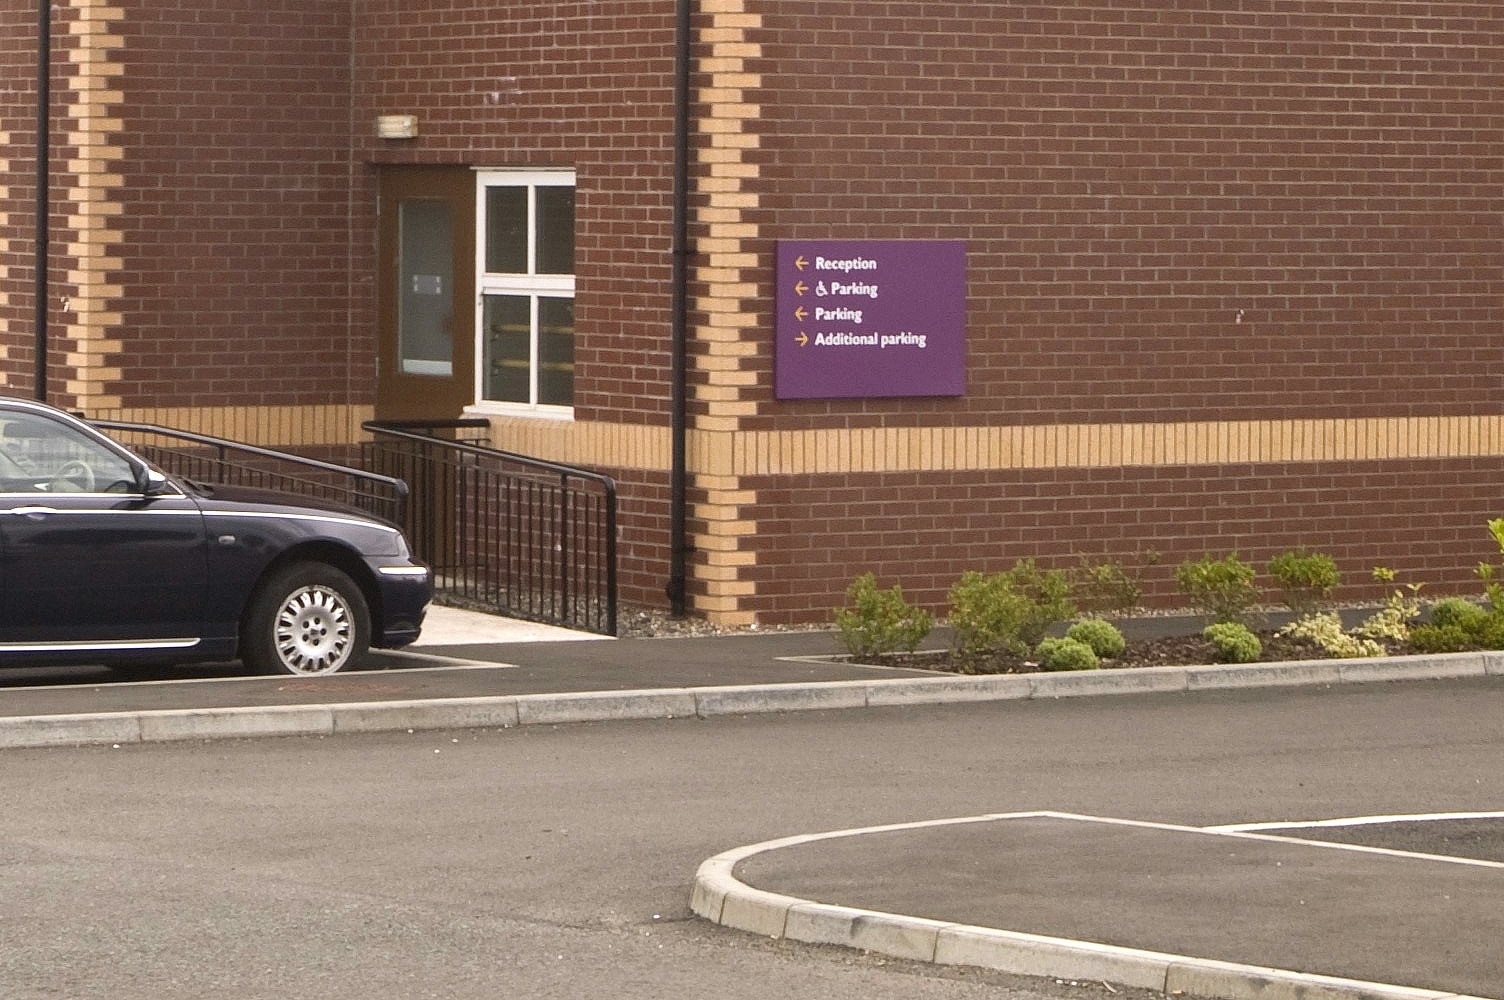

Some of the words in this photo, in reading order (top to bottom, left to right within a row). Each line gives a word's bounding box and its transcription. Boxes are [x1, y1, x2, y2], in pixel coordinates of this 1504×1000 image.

[815, 256, 877, 273] Reception
[831, 282, 878, 298] Parking
[815, 307, 863, 323] Parking
[814, 331, 878, 346] Additional
[880, 332, 926, 348] parking
